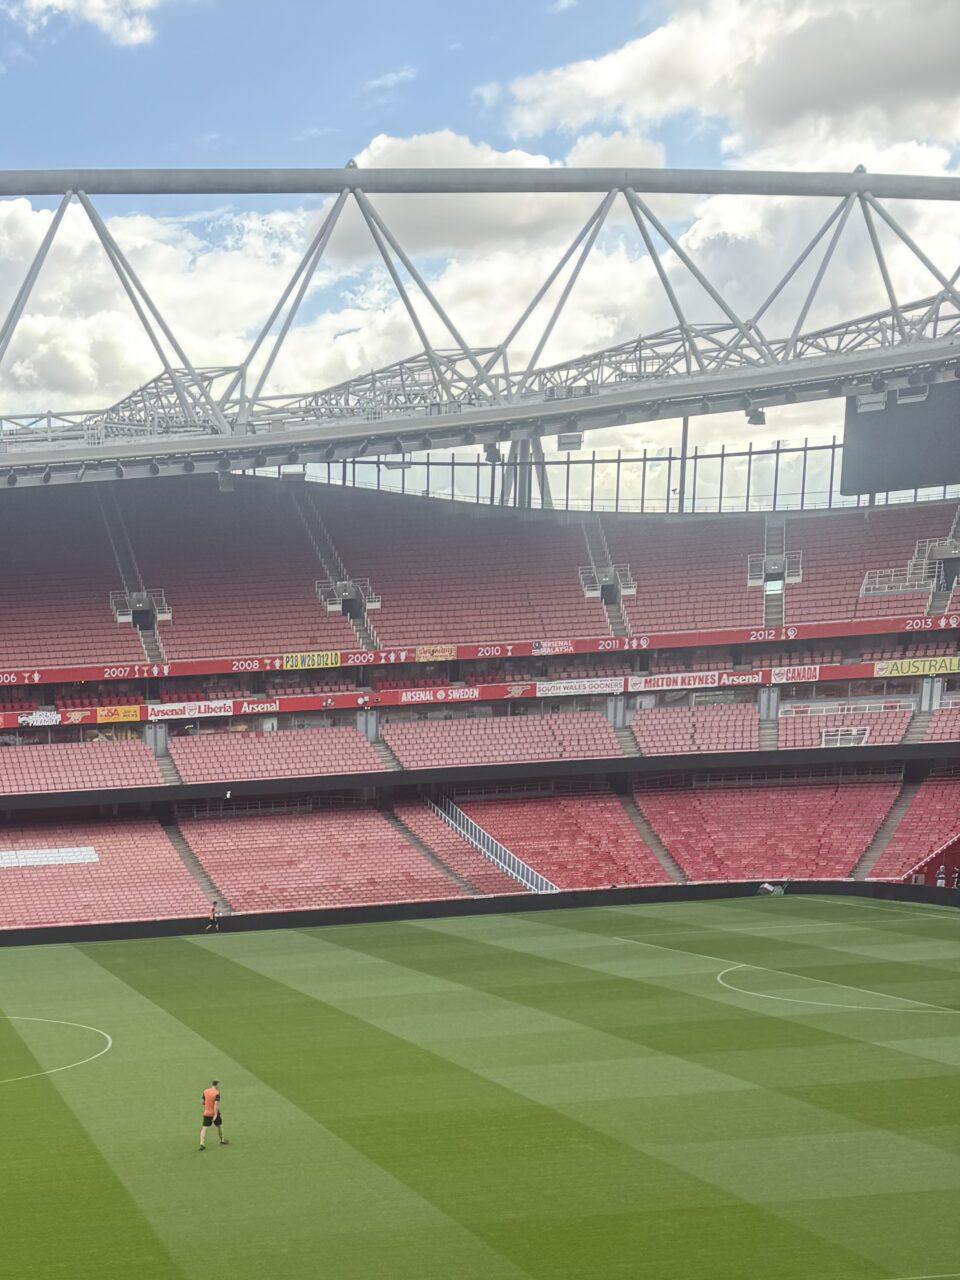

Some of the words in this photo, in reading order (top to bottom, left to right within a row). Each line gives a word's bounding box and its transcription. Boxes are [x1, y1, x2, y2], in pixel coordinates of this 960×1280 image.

[906, 619, 933, 630] 2013
[750, 630, 775, 640] 2012
[598, 640, 618, 650] 2011
[478, 646, 500, 656] 2010
[285, 656, 298, 668] P38
[300, 655, 315, 667] W26
[317, 654, 328, 666] D12
[348, 654, 374, 664] 2009
[232, 660, 259, 670] 2008
[104, 668, 130, 678] 2007
[720, 672, 762, 685] Arsenal
[786, 667, 817, 681] CANADA
[589, 682, 622, 690] GOONERS
[644, 677, 678, 689] MILTON
[681, 674, 716, 686] KEYNES
[402, 691, 434, 702] ARSENAL
[448, 688, 479, 700] SWEDEN
[150, 706, 186, 717] Arsenal
[198, 704, 232, 714] Liberia
[241, 700, 279, 712] Arsenal
